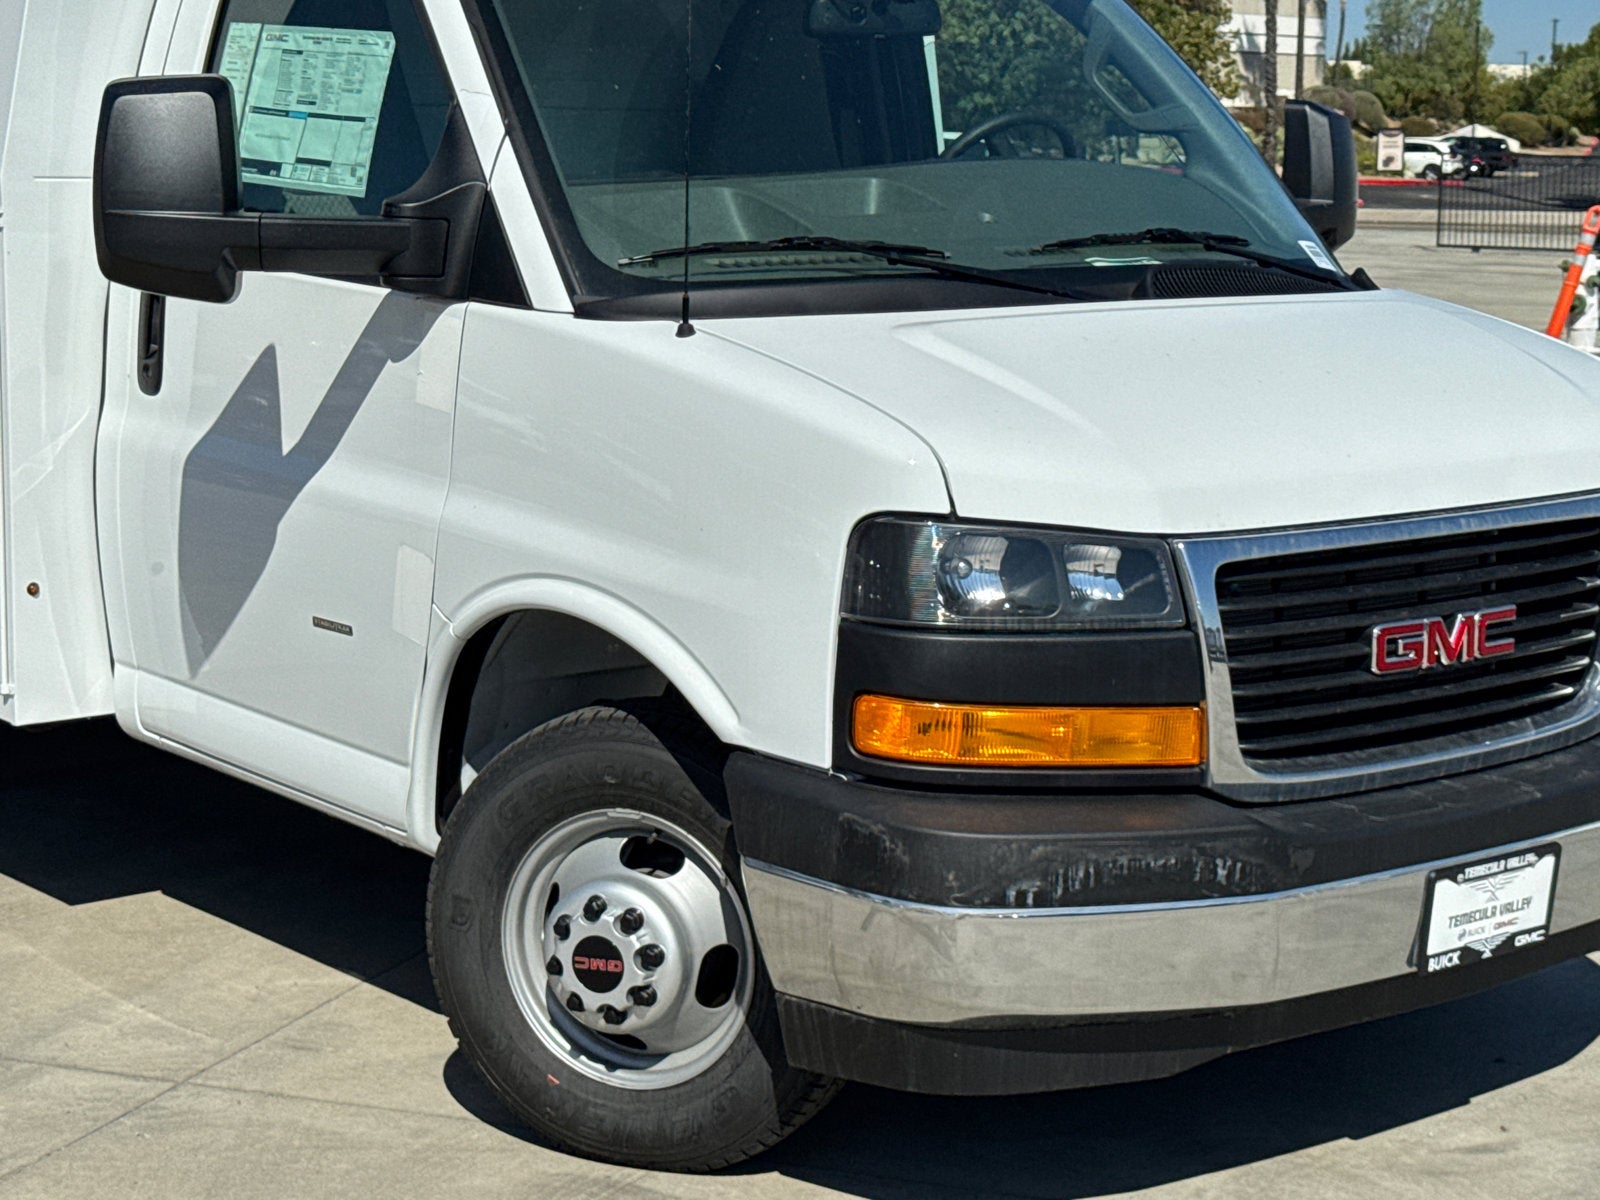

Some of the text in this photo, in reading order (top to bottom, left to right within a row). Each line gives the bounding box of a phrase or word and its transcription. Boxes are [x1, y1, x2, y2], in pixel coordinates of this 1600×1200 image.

[1371, 604, 1517, 676] GMC
[1448, 896, 1533, 929] TEMECULA VALLEY
[1493, 917, 1520, 930] GMC
[1514, 929, 1547, 947] GMC
[574, 956, 623, 972] GMC
[1428, 950, 1462, 973] BUICK
